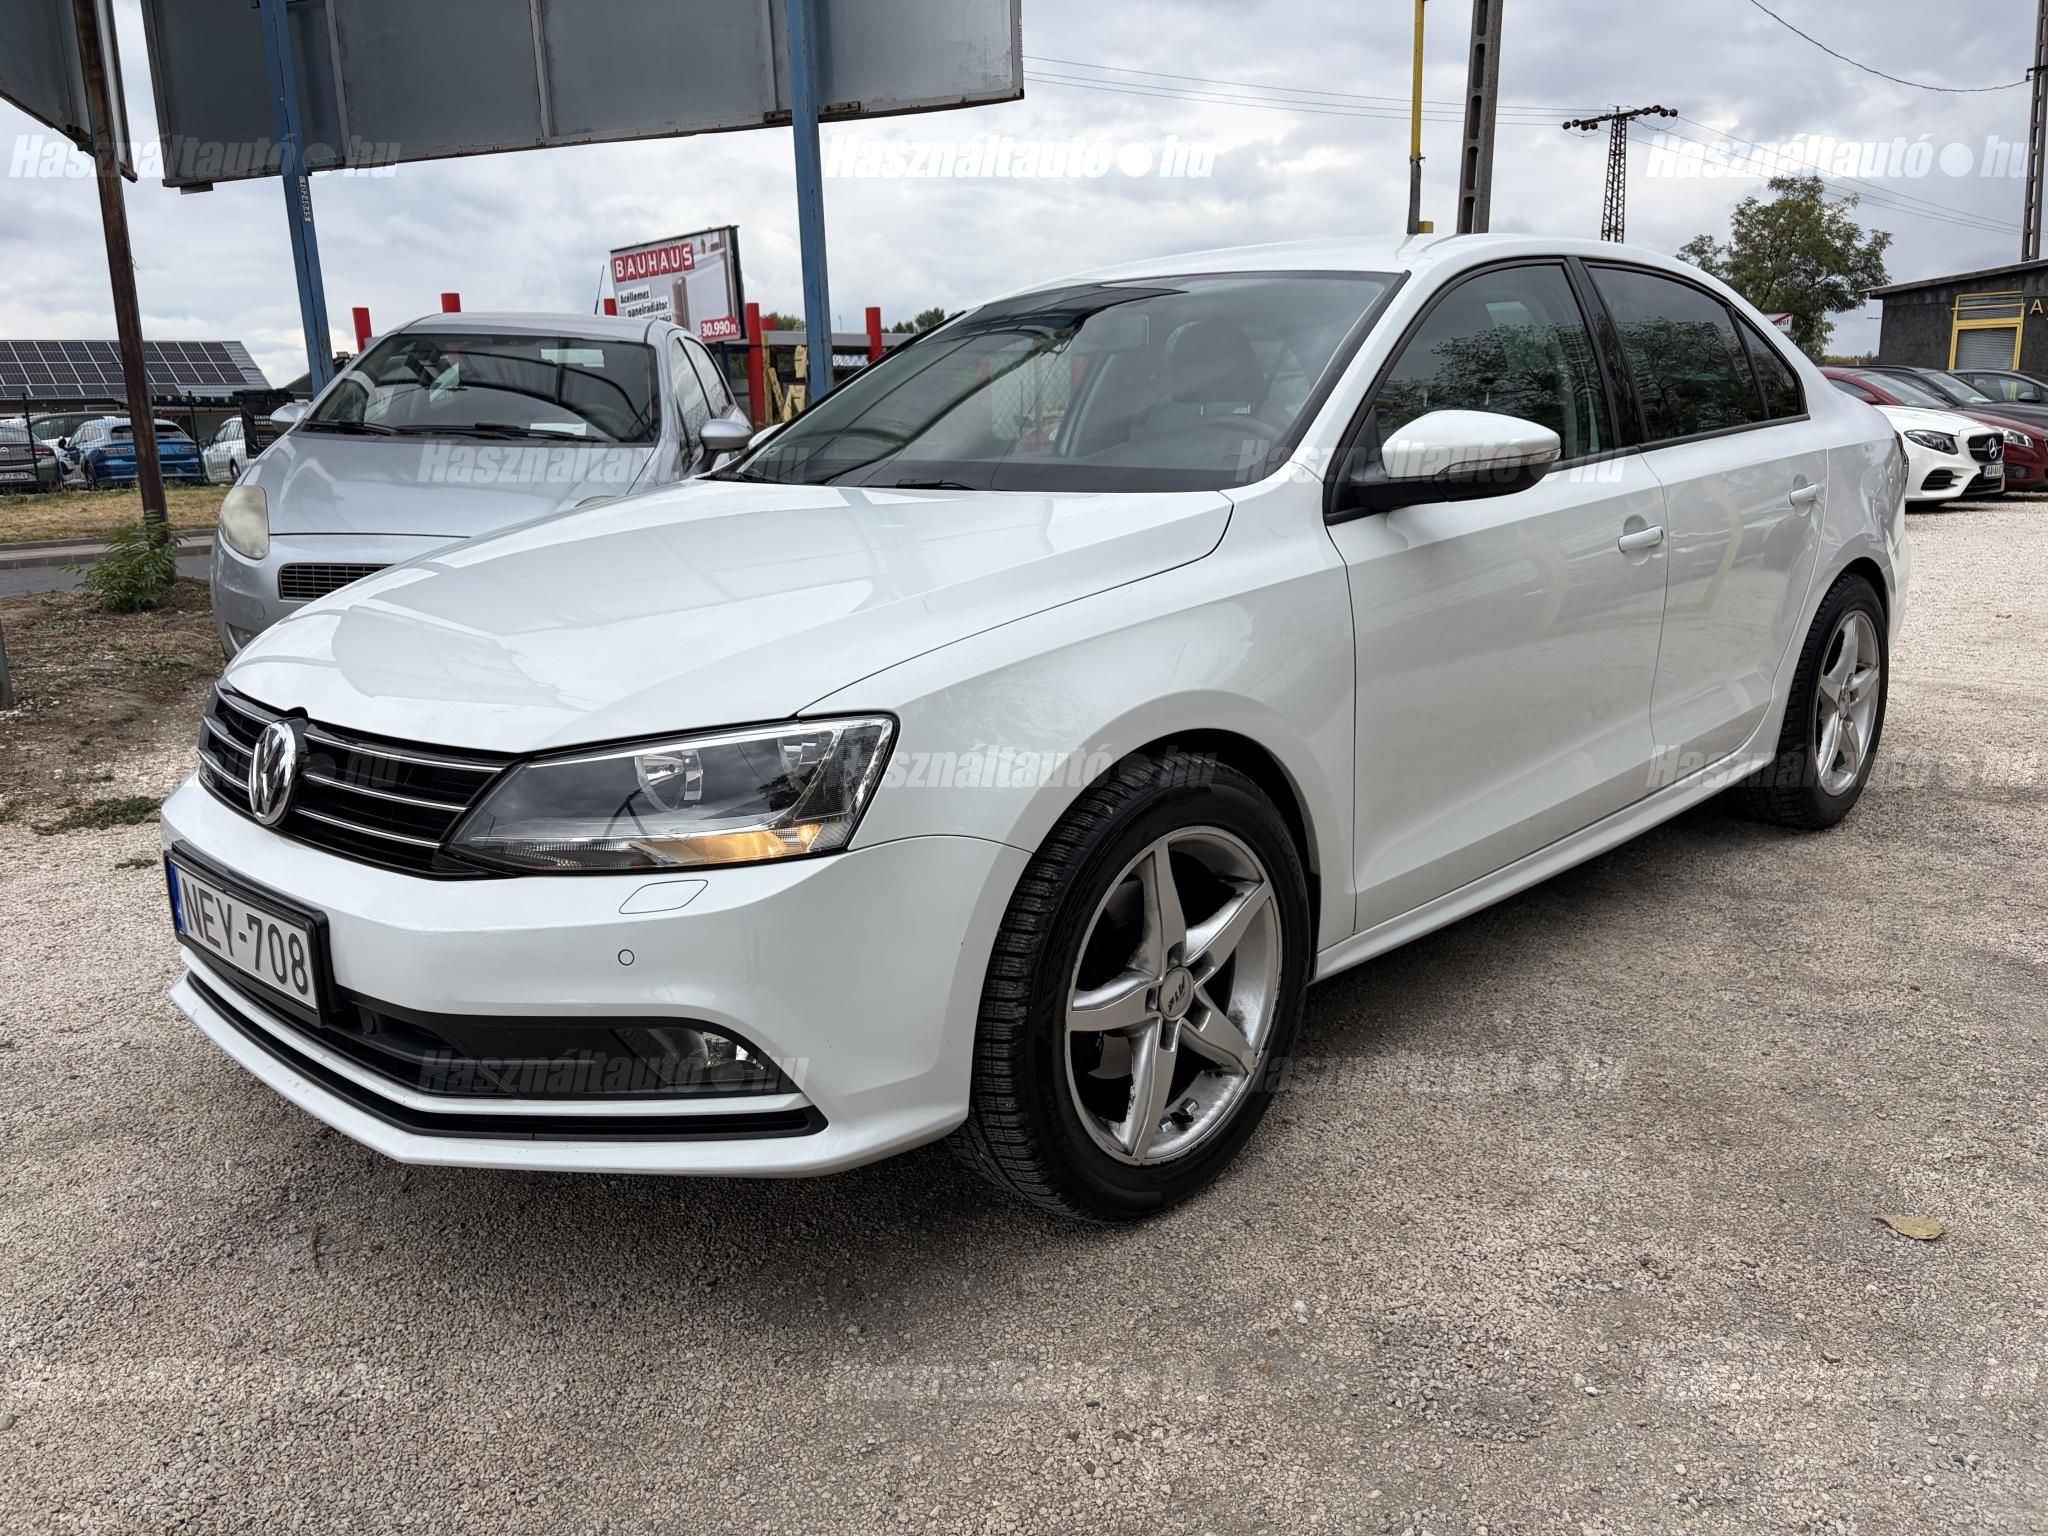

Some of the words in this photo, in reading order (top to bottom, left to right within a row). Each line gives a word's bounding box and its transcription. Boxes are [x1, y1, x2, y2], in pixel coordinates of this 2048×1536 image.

[616, 246, 693, 278] BAUHAUS
[620, 290, 649, 304] Acéllemez
[627, 300, 668, 318] panelradiátor
[702, 320, 730, 337] 30.990
[182, 877, 308, 996] NEY-708
